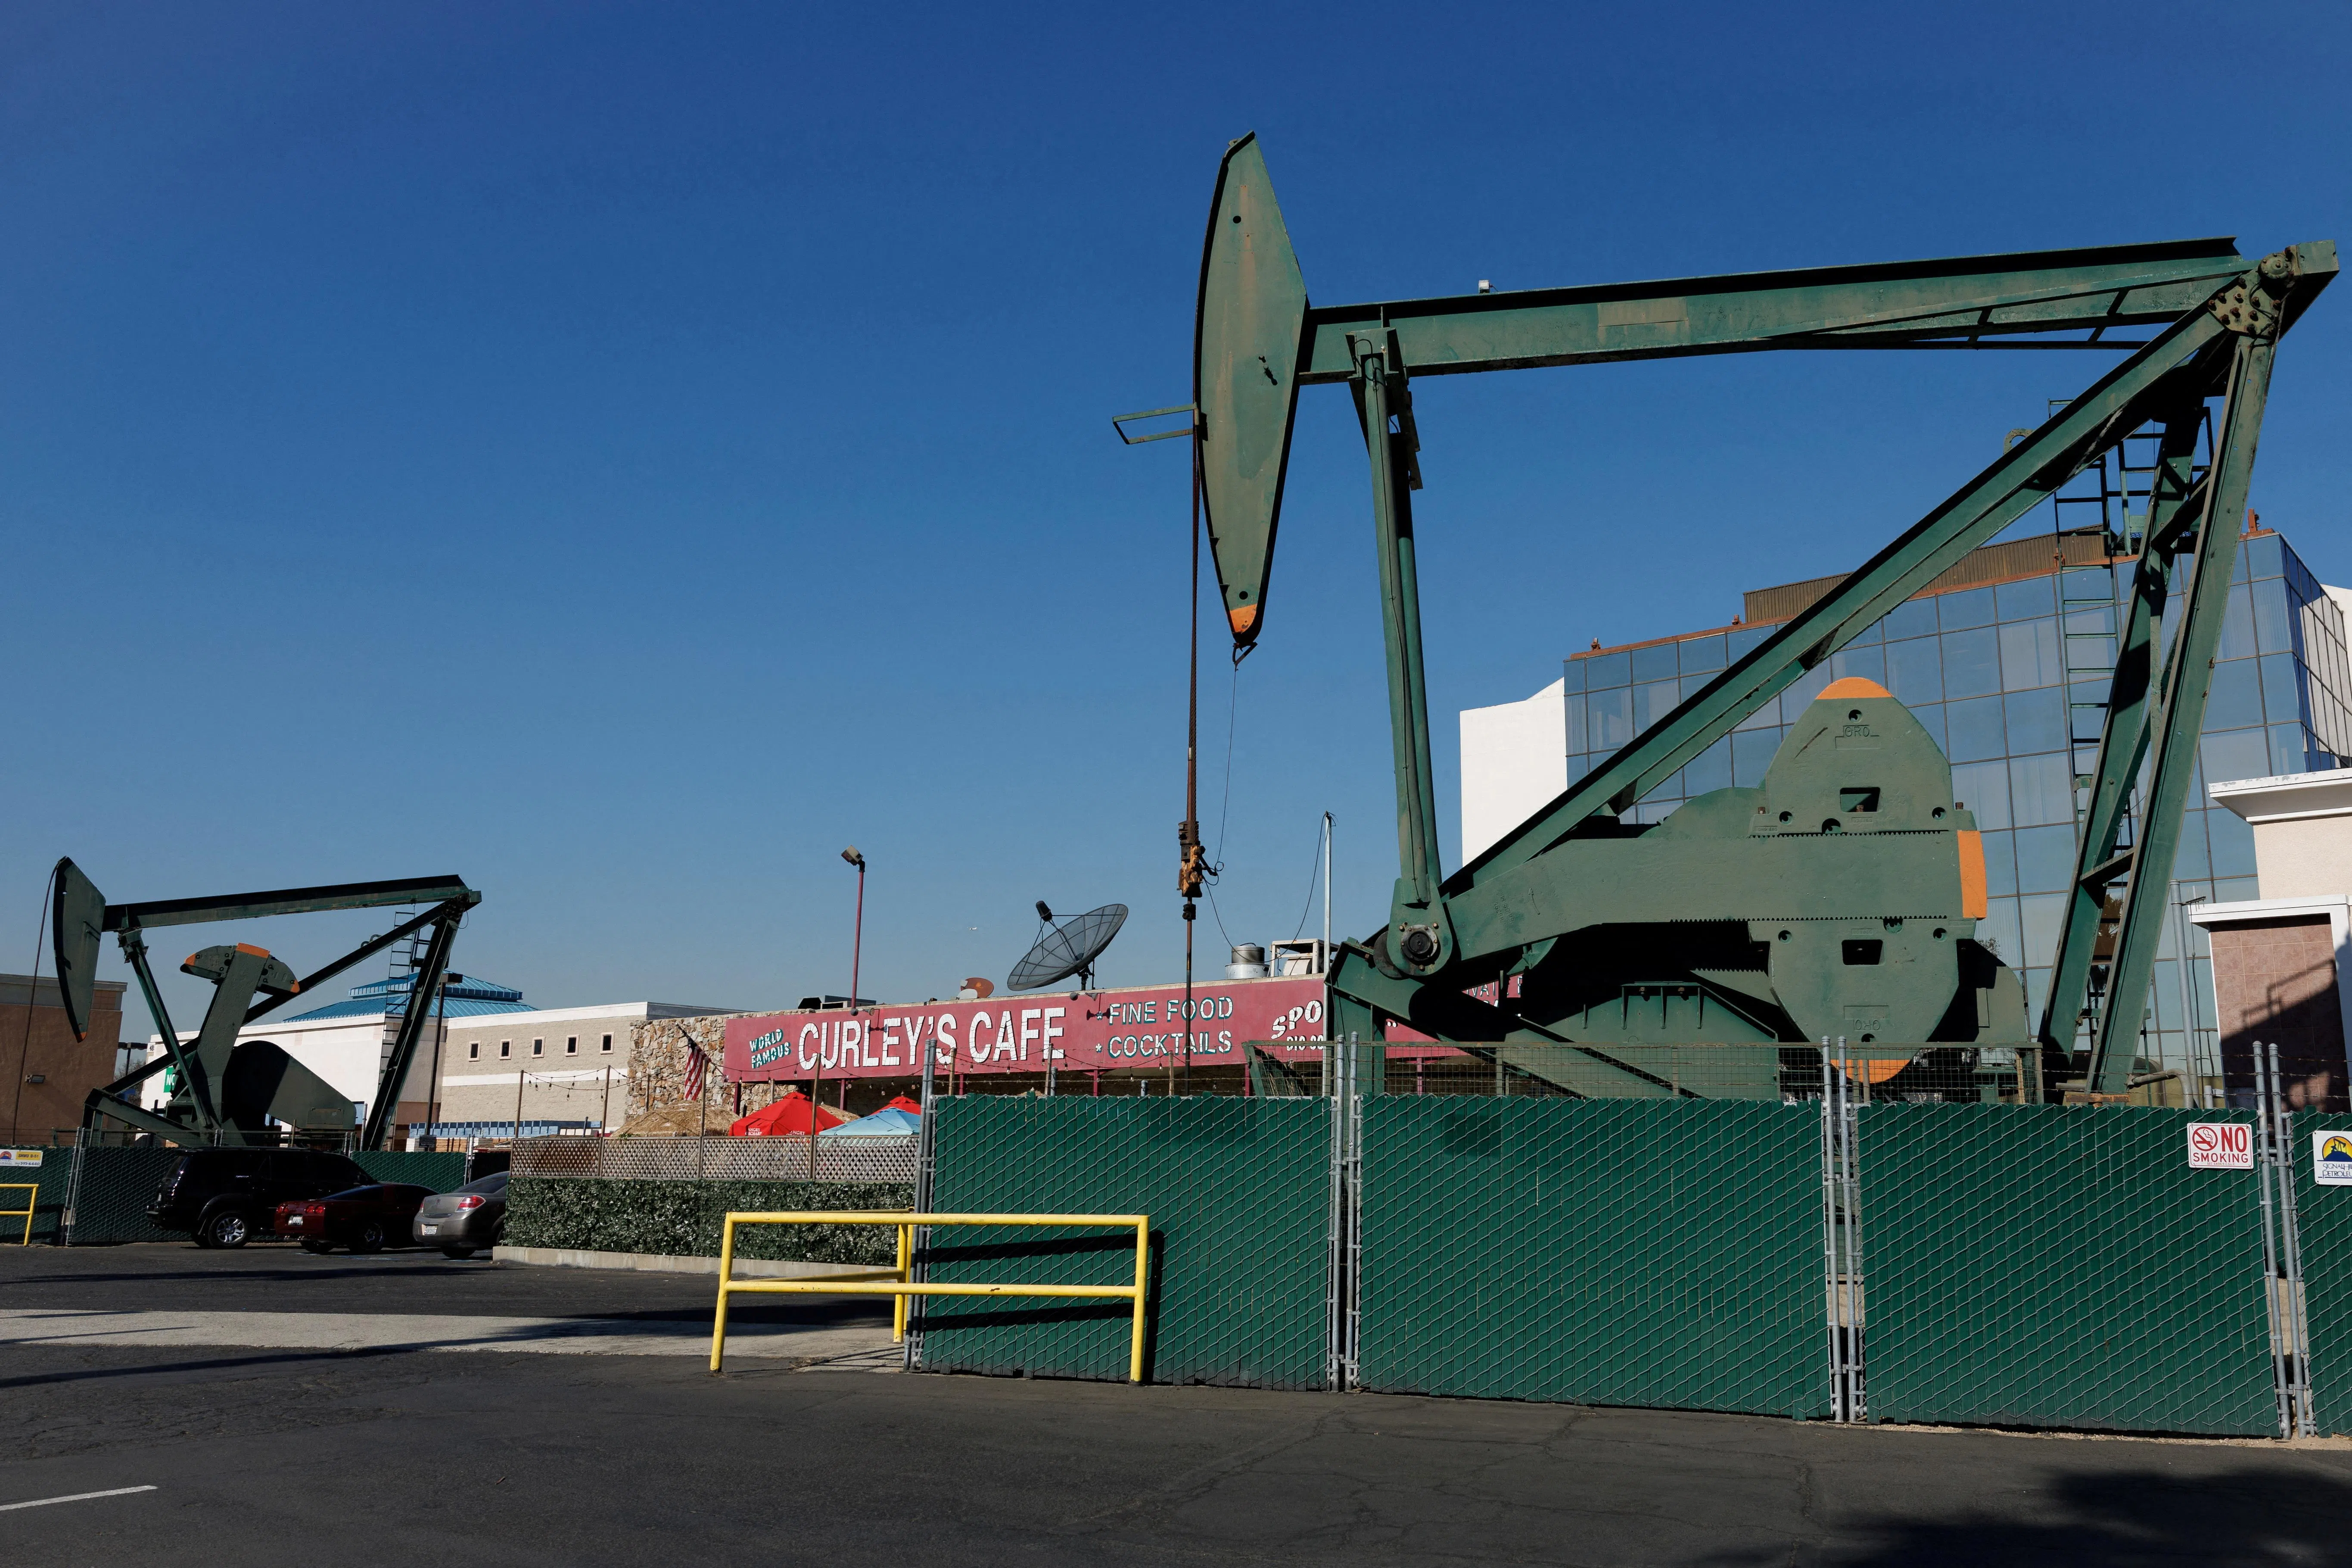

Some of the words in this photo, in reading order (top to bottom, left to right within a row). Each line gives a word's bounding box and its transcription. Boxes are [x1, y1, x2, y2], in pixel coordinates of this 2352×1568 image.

[1109, 1001, 1156, 1025] FINE
[1167, 996, 1233, 1022] FOOD
[750, 1029, 783, 1052] WORLD
[799, 1014, 957, 1070] CURLEY'S
[969, 1007, 1066, 1063] CAFE
[1108, 1030, 1232, 1058] COCKTAILS
[751, 1042, 791, 1069] FAMOUS
[2221, 1127, 2247, 1152] NO
[2193, 1152, 2248, 1163] SMOKING
